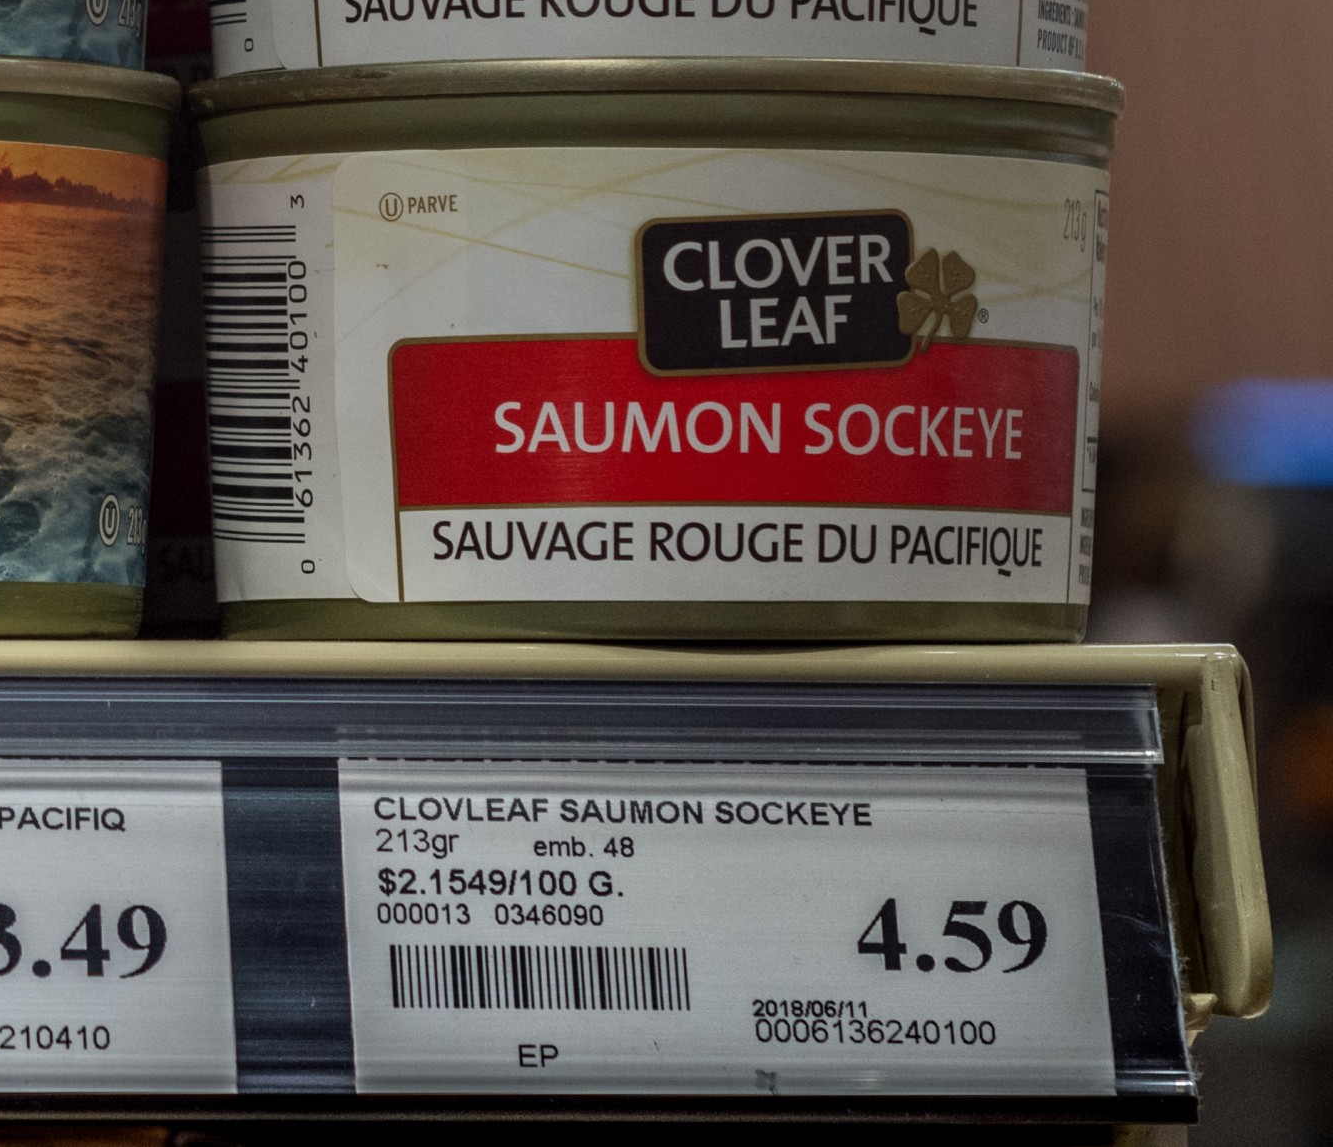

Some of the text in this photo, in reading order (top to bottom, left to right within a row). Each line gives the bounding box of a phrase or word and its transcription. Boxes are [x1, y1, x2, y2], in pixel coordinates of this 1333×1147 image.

[407, 195, 458, 214] PARVE
[663, 234, 893, 291] CLOVER
[720, 295, 852, 350] LEAF
[494, 401, 1023, 460] SAUMON SOCKEYE
[374, 797, 872, 826] CLOVLEAF SAUMON SOCKEYE
[376, 829, 634, 858] 213gr emb. 48
[378, 868, 624, 897] $2.1549/100 G.
[377, 904, 603, 925] 000013 0346090
[857, 898, 1048, 973] 4.59
[752, 1000, 867, 1018] 2018/06/11
[755, 1019, 996, 1045] 0006136240100
[519, 1045, 558, 1067] EP
